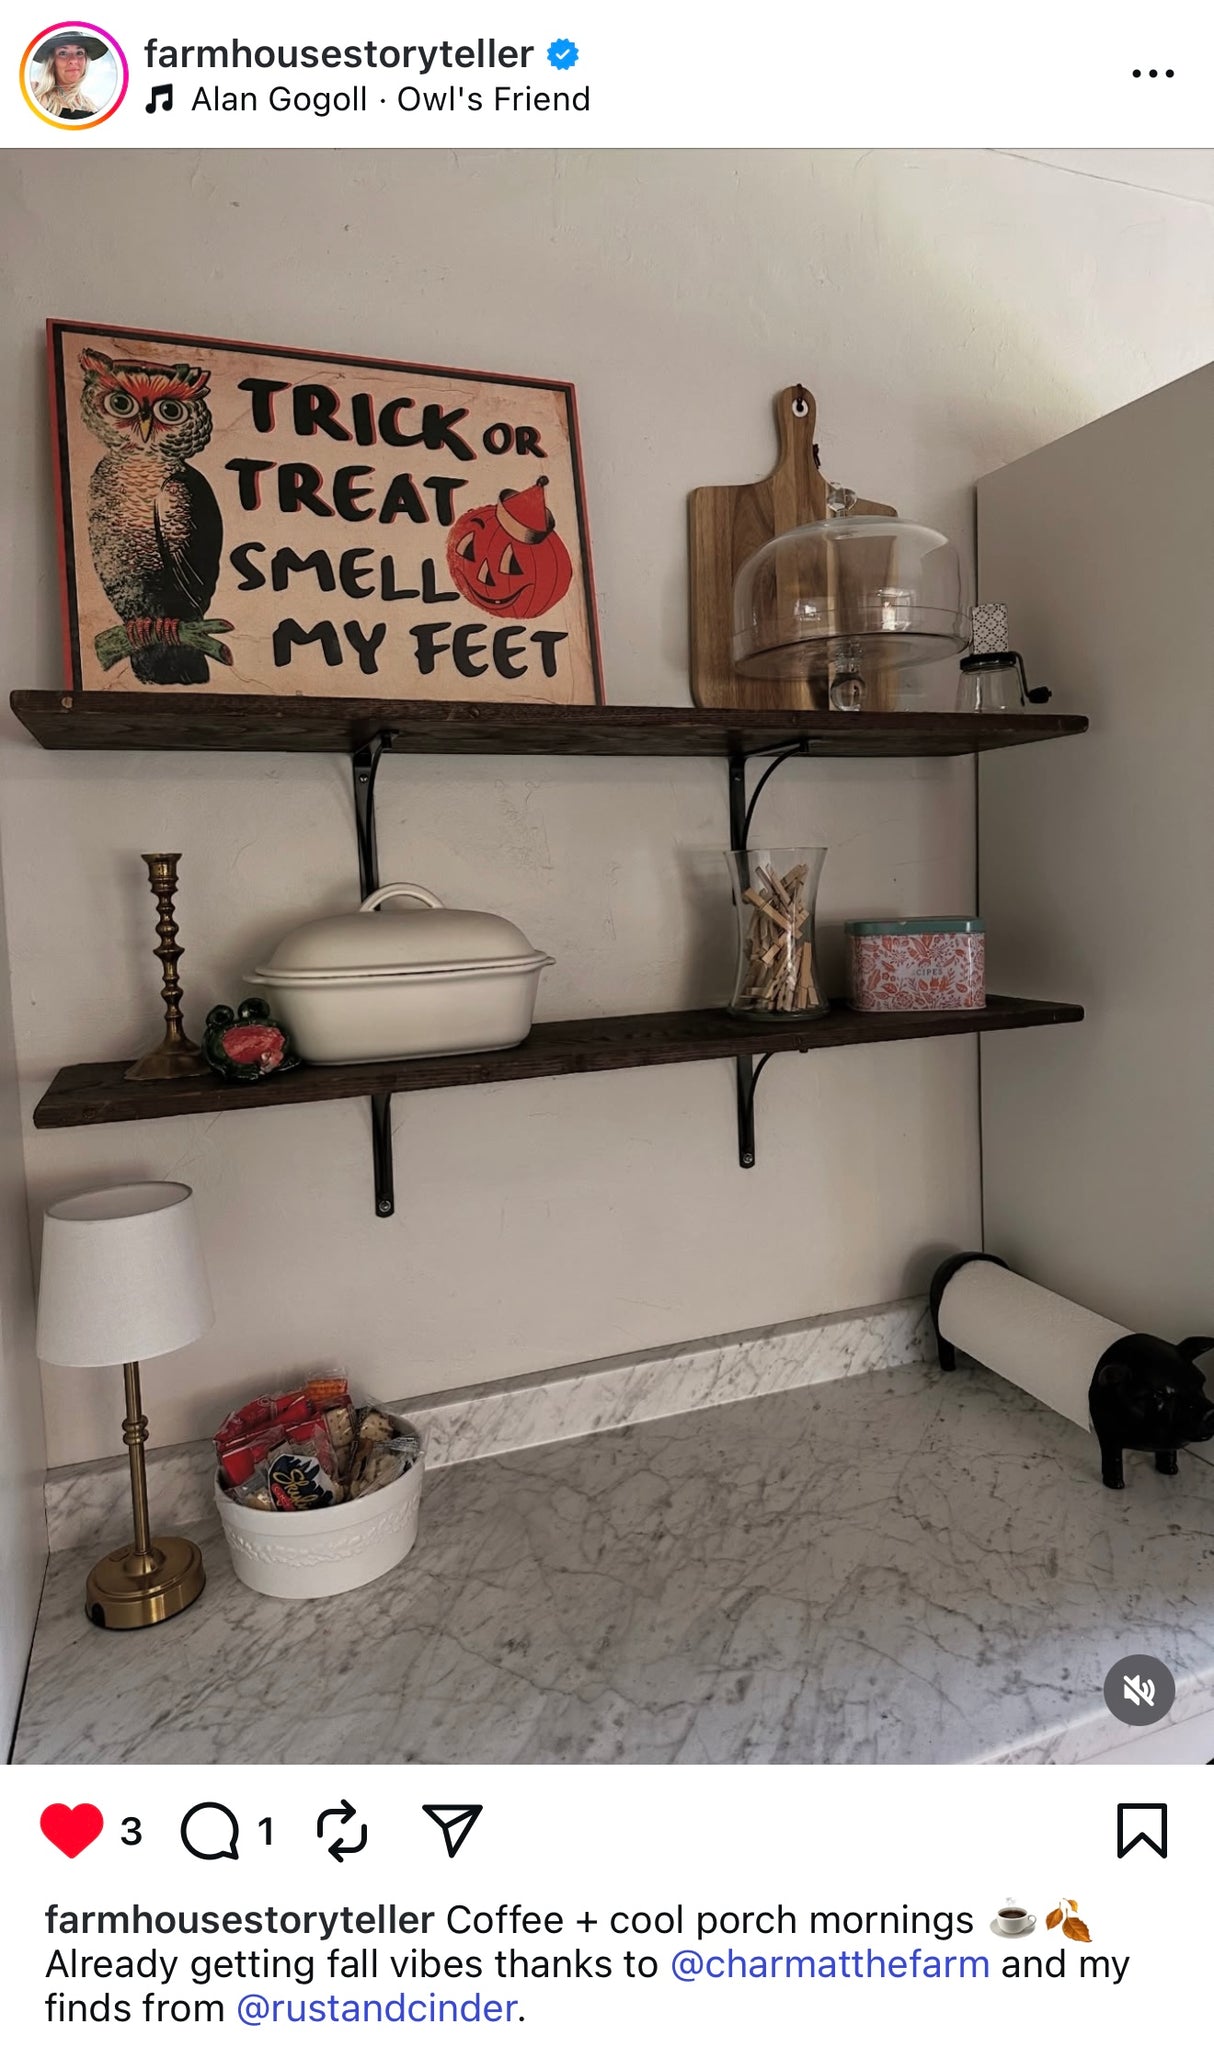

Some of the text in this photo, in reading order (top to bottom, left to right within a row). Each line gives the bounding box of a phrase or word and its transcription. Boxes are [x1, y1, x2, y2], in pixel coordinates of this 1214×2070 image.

[237, 377, 548, 462] TRICK OR
[224, 457, 470, 527] TREAT
[229, 541, 461, 604] SMELL
[272, 617, 569, 679] MY FEET
[912, 967, 943, 977] CIPES
